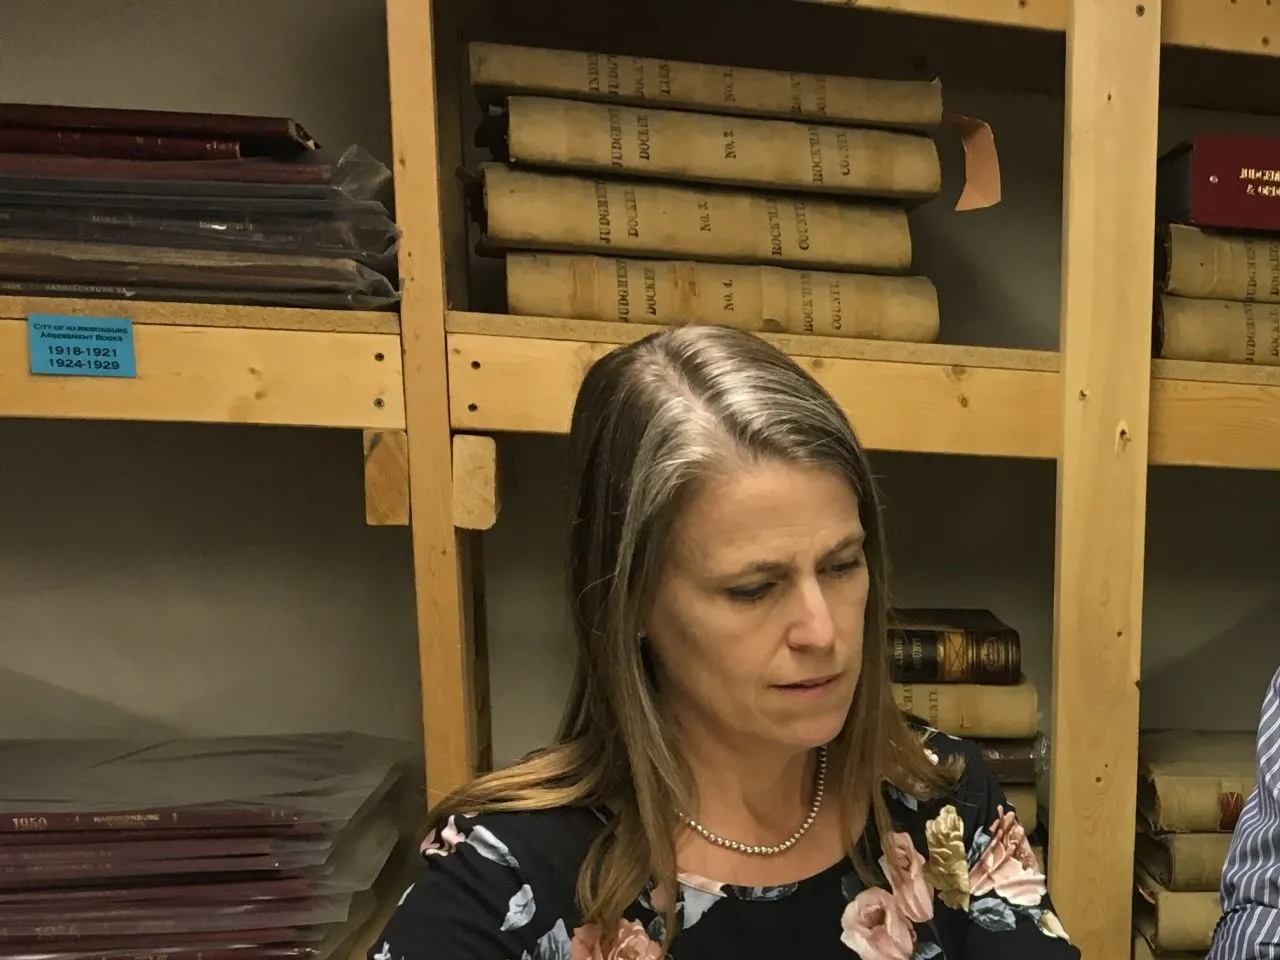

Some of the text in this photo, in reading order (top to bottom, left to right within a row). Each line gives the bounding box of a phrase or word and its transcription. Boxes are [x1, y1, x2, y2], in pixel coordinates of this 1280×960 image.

[725, 141, 736, 160] No.
[1246, 184, 1255, 196] &
[700, 213, 711, 232] No.
[724, 292, 734, 312] No.
[48, 346, 117, 357] 1918-1921
[49, 358, 120, 370] 1924-1929
